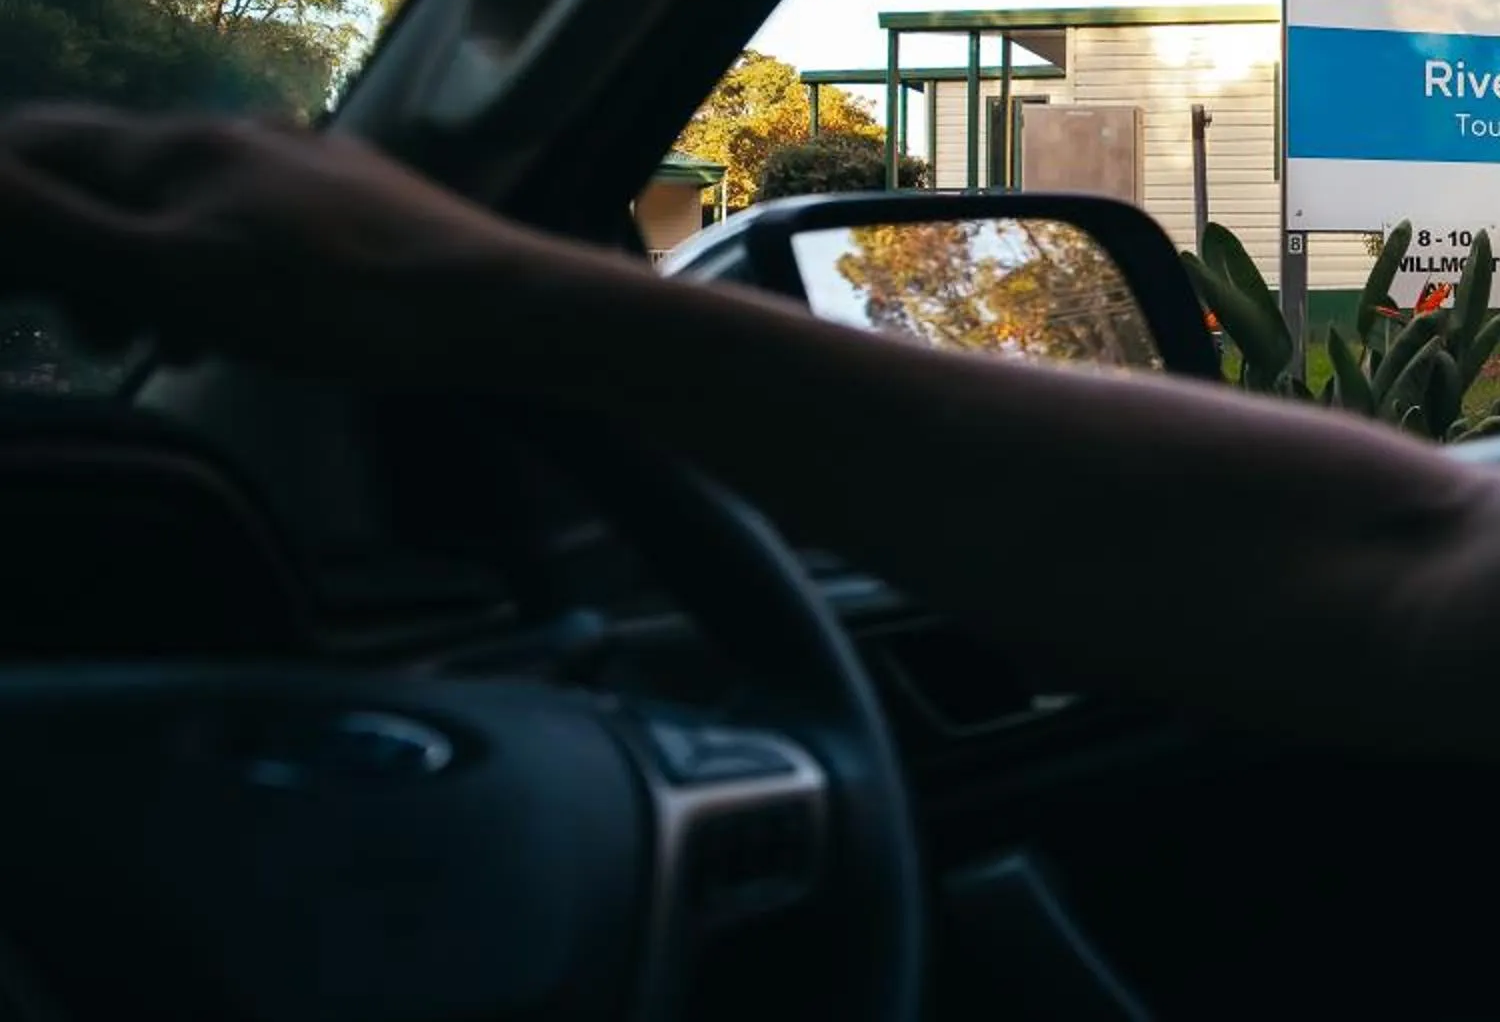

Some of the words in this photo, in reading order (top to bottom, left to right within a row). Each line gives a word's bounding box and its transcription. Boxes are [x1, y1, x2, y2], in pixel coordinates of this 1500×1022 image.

[1418, 230, 1431, 247] 8
[1447, 230, 1473, 247] 10
[1398, 256, 1500, 273] ILLMT
